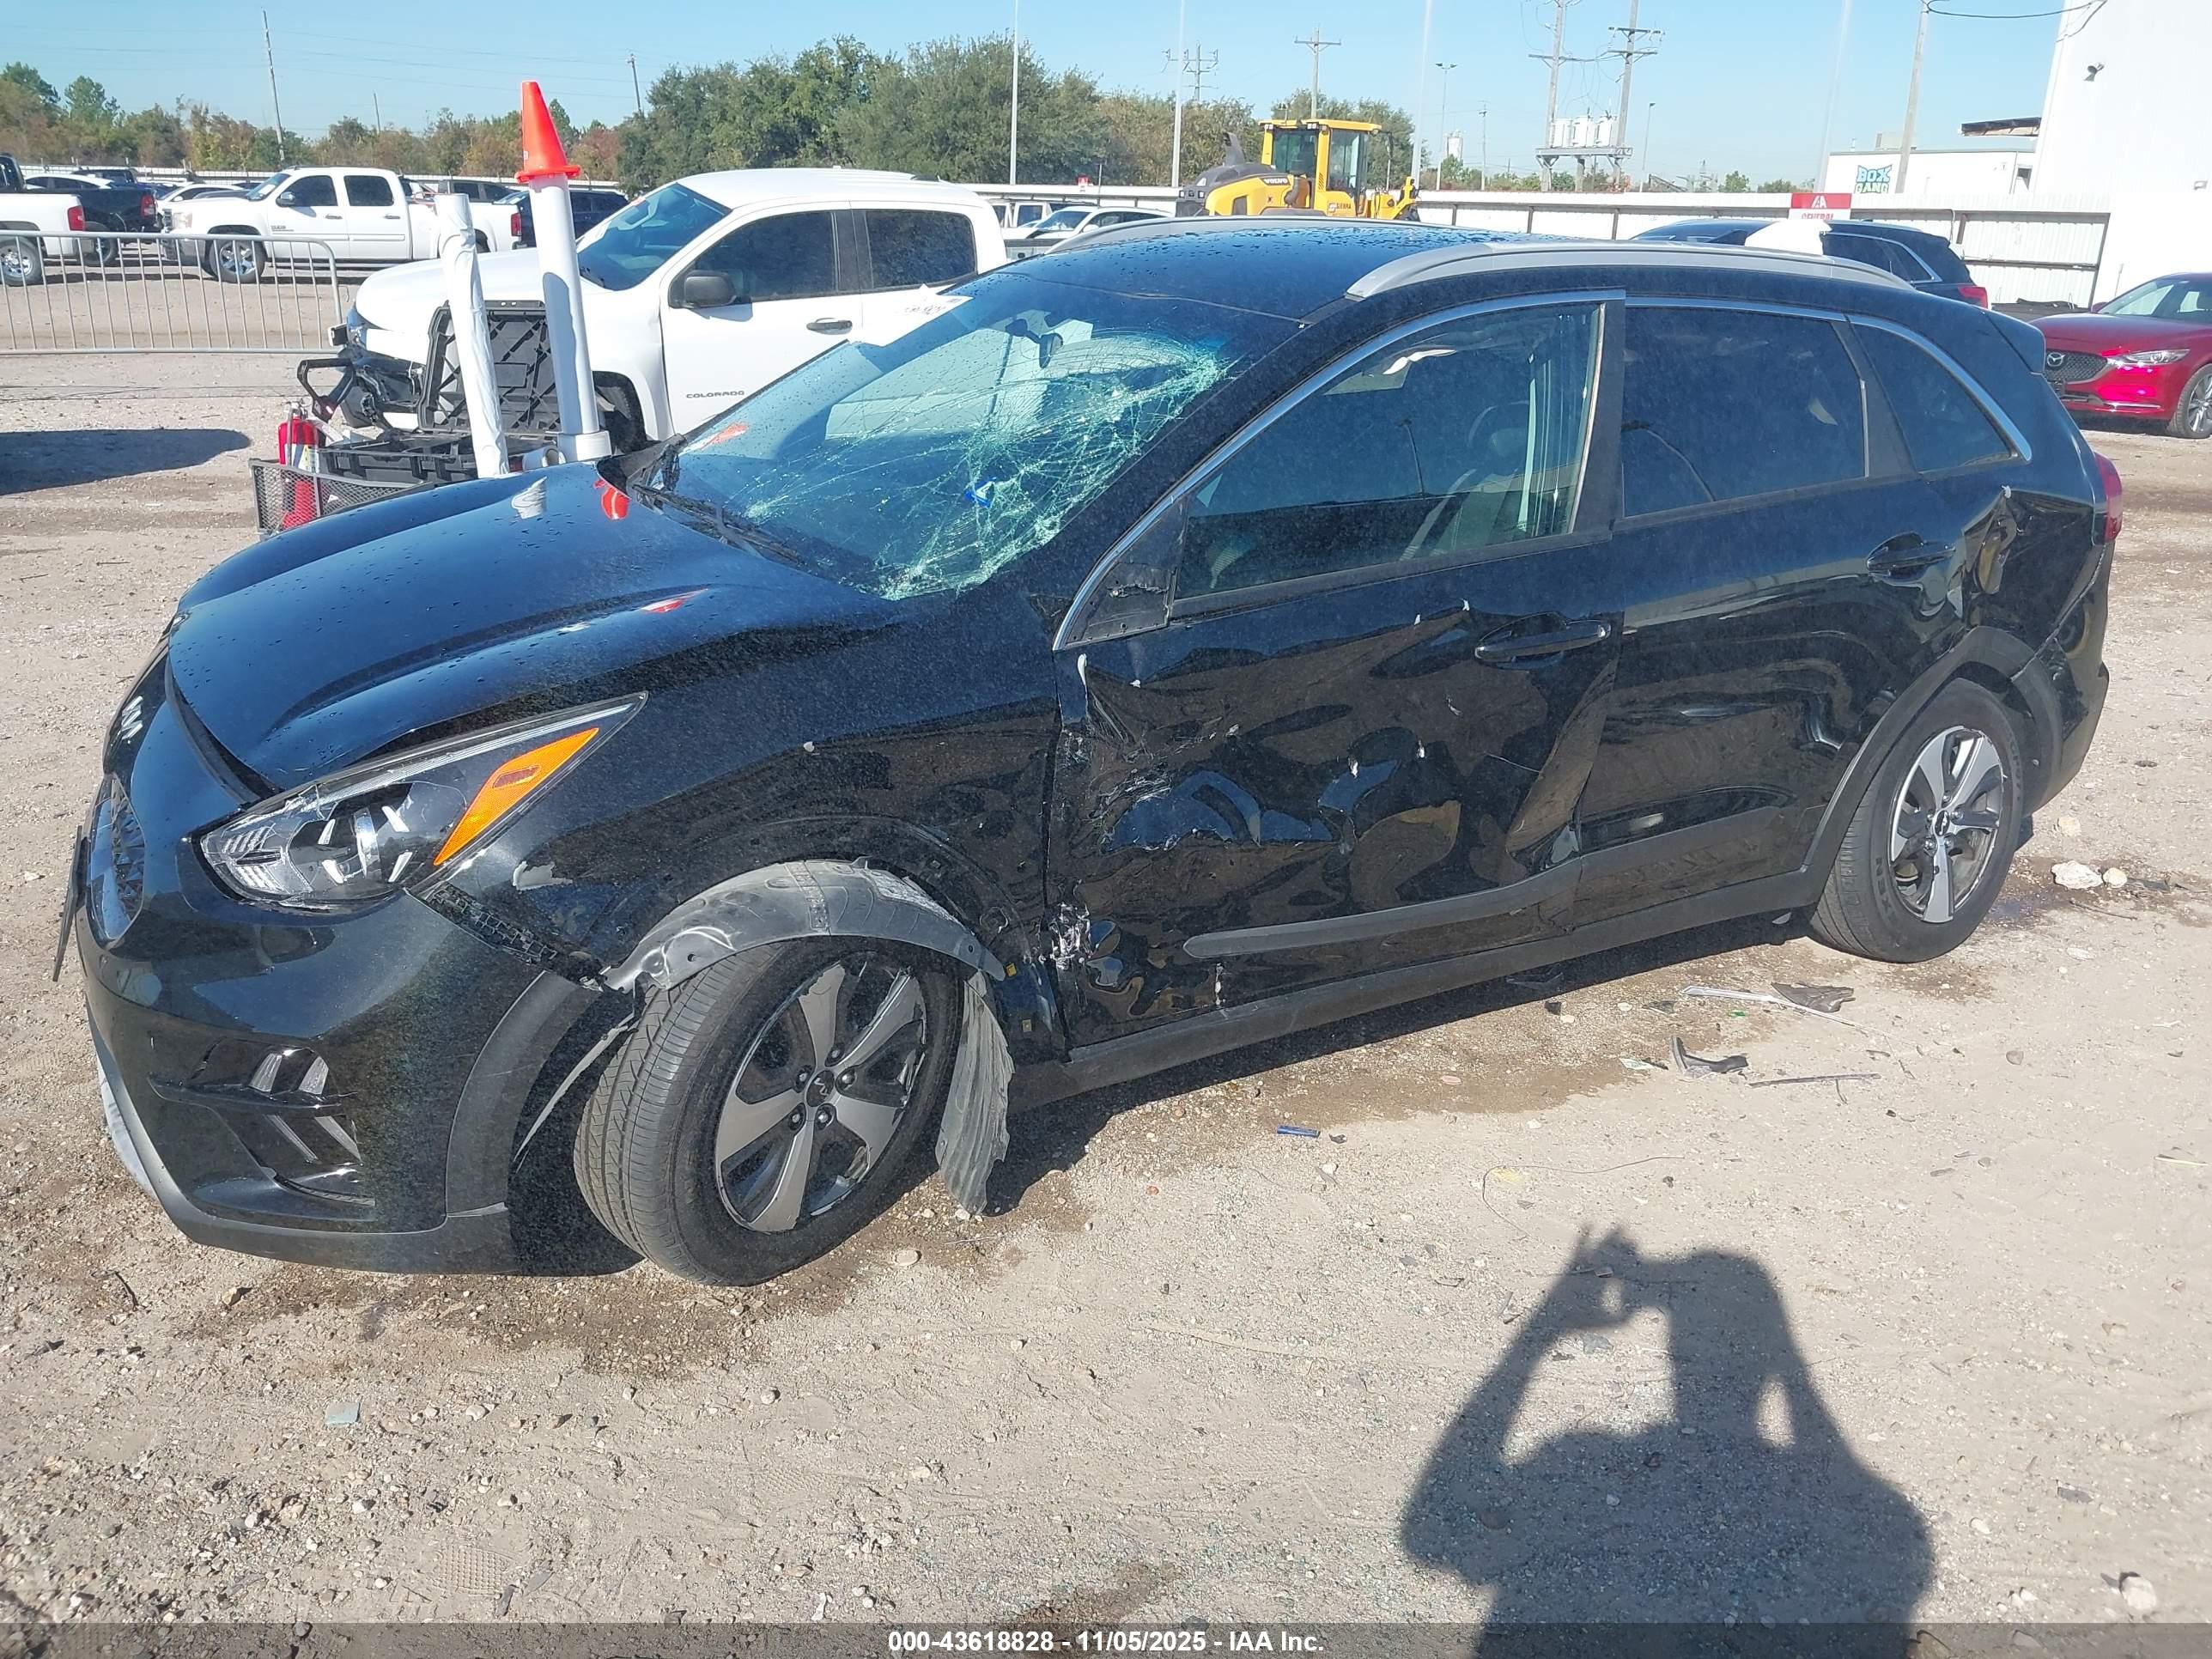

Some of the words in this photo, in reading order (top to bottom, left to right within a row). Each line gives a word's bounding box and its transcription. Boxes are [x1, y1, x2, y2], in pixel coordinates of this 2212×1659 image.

[1856, 164, 1893, 183] BOX
[1855, 182, 1890, 193] GANG
[686, 390, 745, 398] COLORADO
